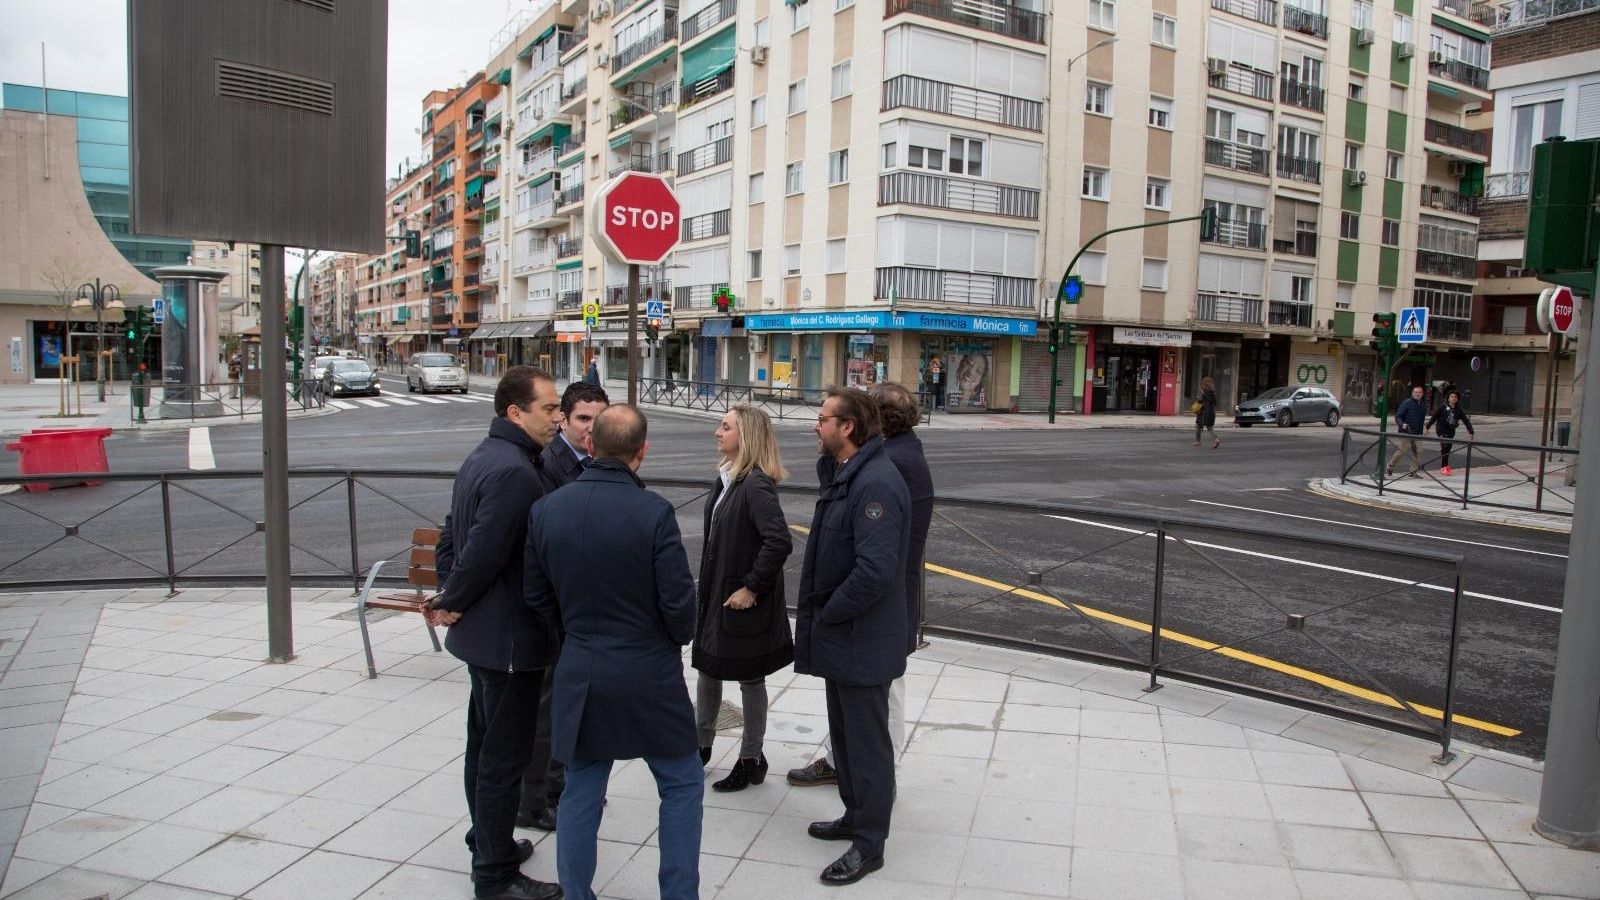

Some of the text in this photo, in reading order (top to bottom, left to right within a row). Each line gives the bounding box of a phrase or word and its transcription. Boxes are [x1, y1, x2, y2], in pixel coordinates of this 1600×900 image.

[611, 205, 674, 231] STOP
[1555, 304, 1572, 316] STOP
[809, 316, 818, 324] del
[818, 316, 825, 324] C.
[855, 315, 879, 326] Gallego
[920, 315, 1010, 332] farmacia Mónica
[1019, 321, 1028, 333] fm
